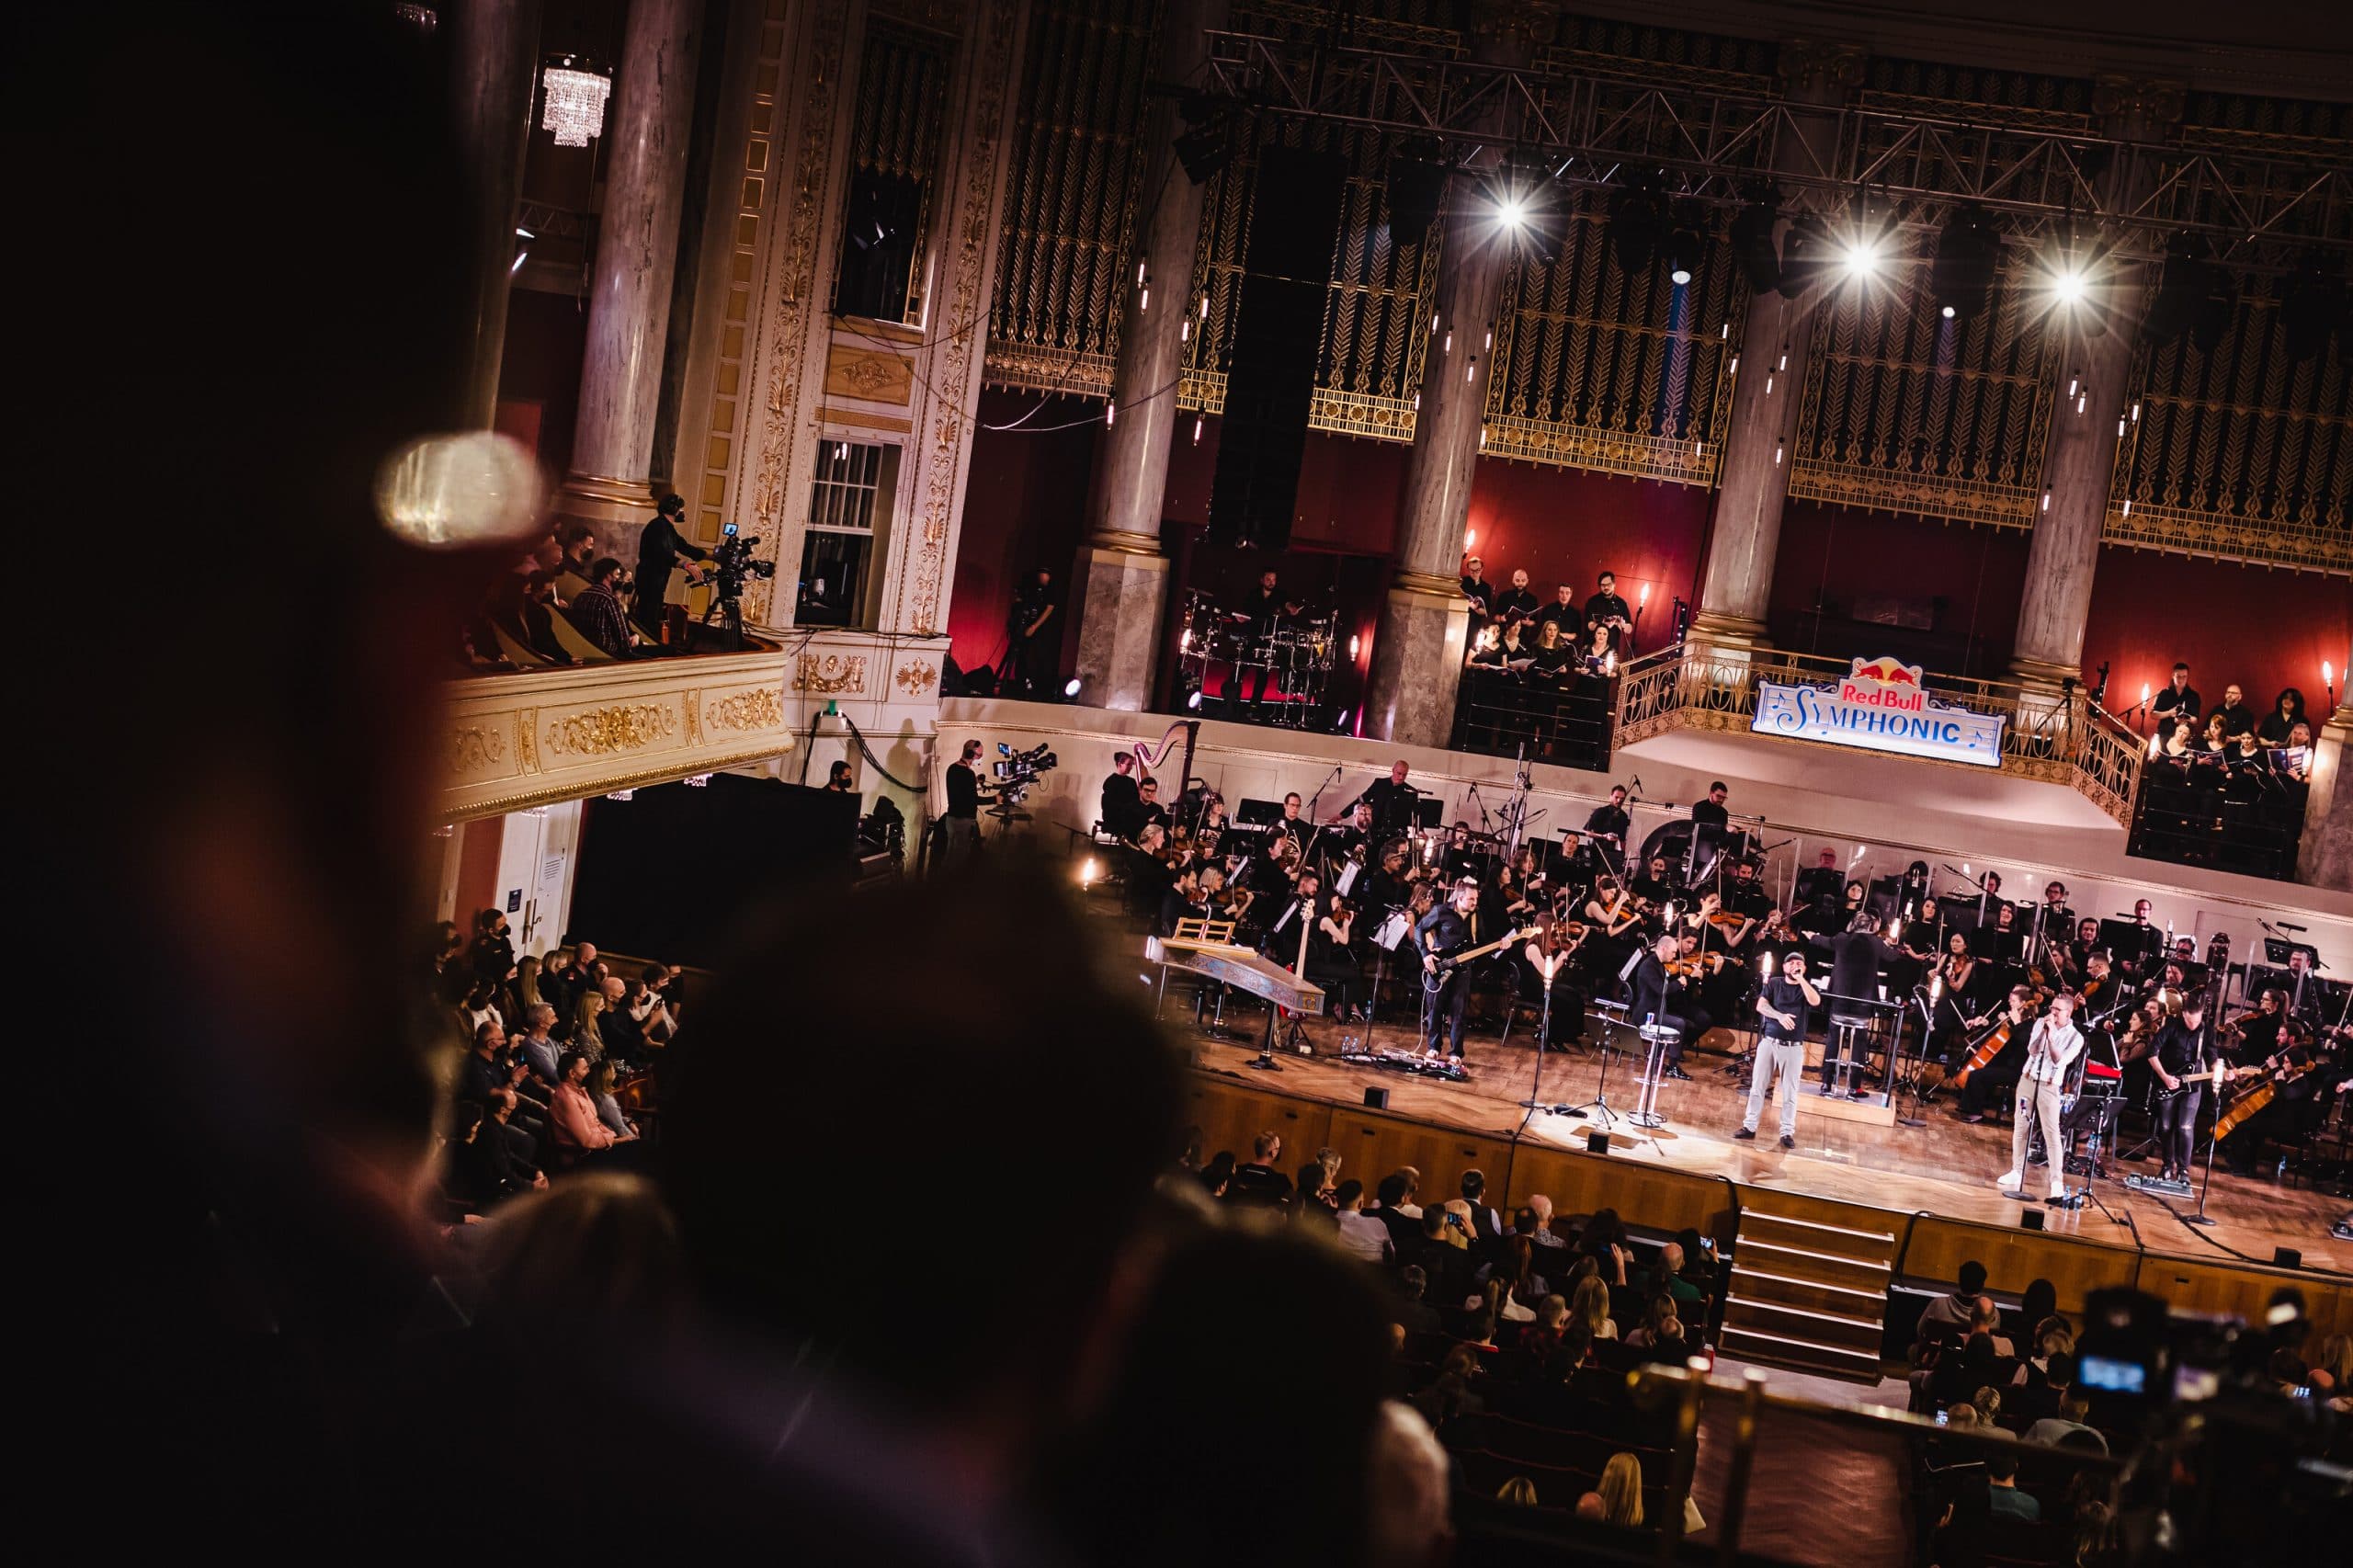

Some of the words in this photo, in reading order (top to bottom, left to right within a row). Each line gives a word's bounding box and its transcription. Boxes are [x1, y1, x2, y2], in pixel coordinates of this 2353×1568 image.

[1777, 688, 1961, 744] SYMPHONIC
[1842, 684, 1881, 706] Red
[1884, 689, 1923, 712] Bull
